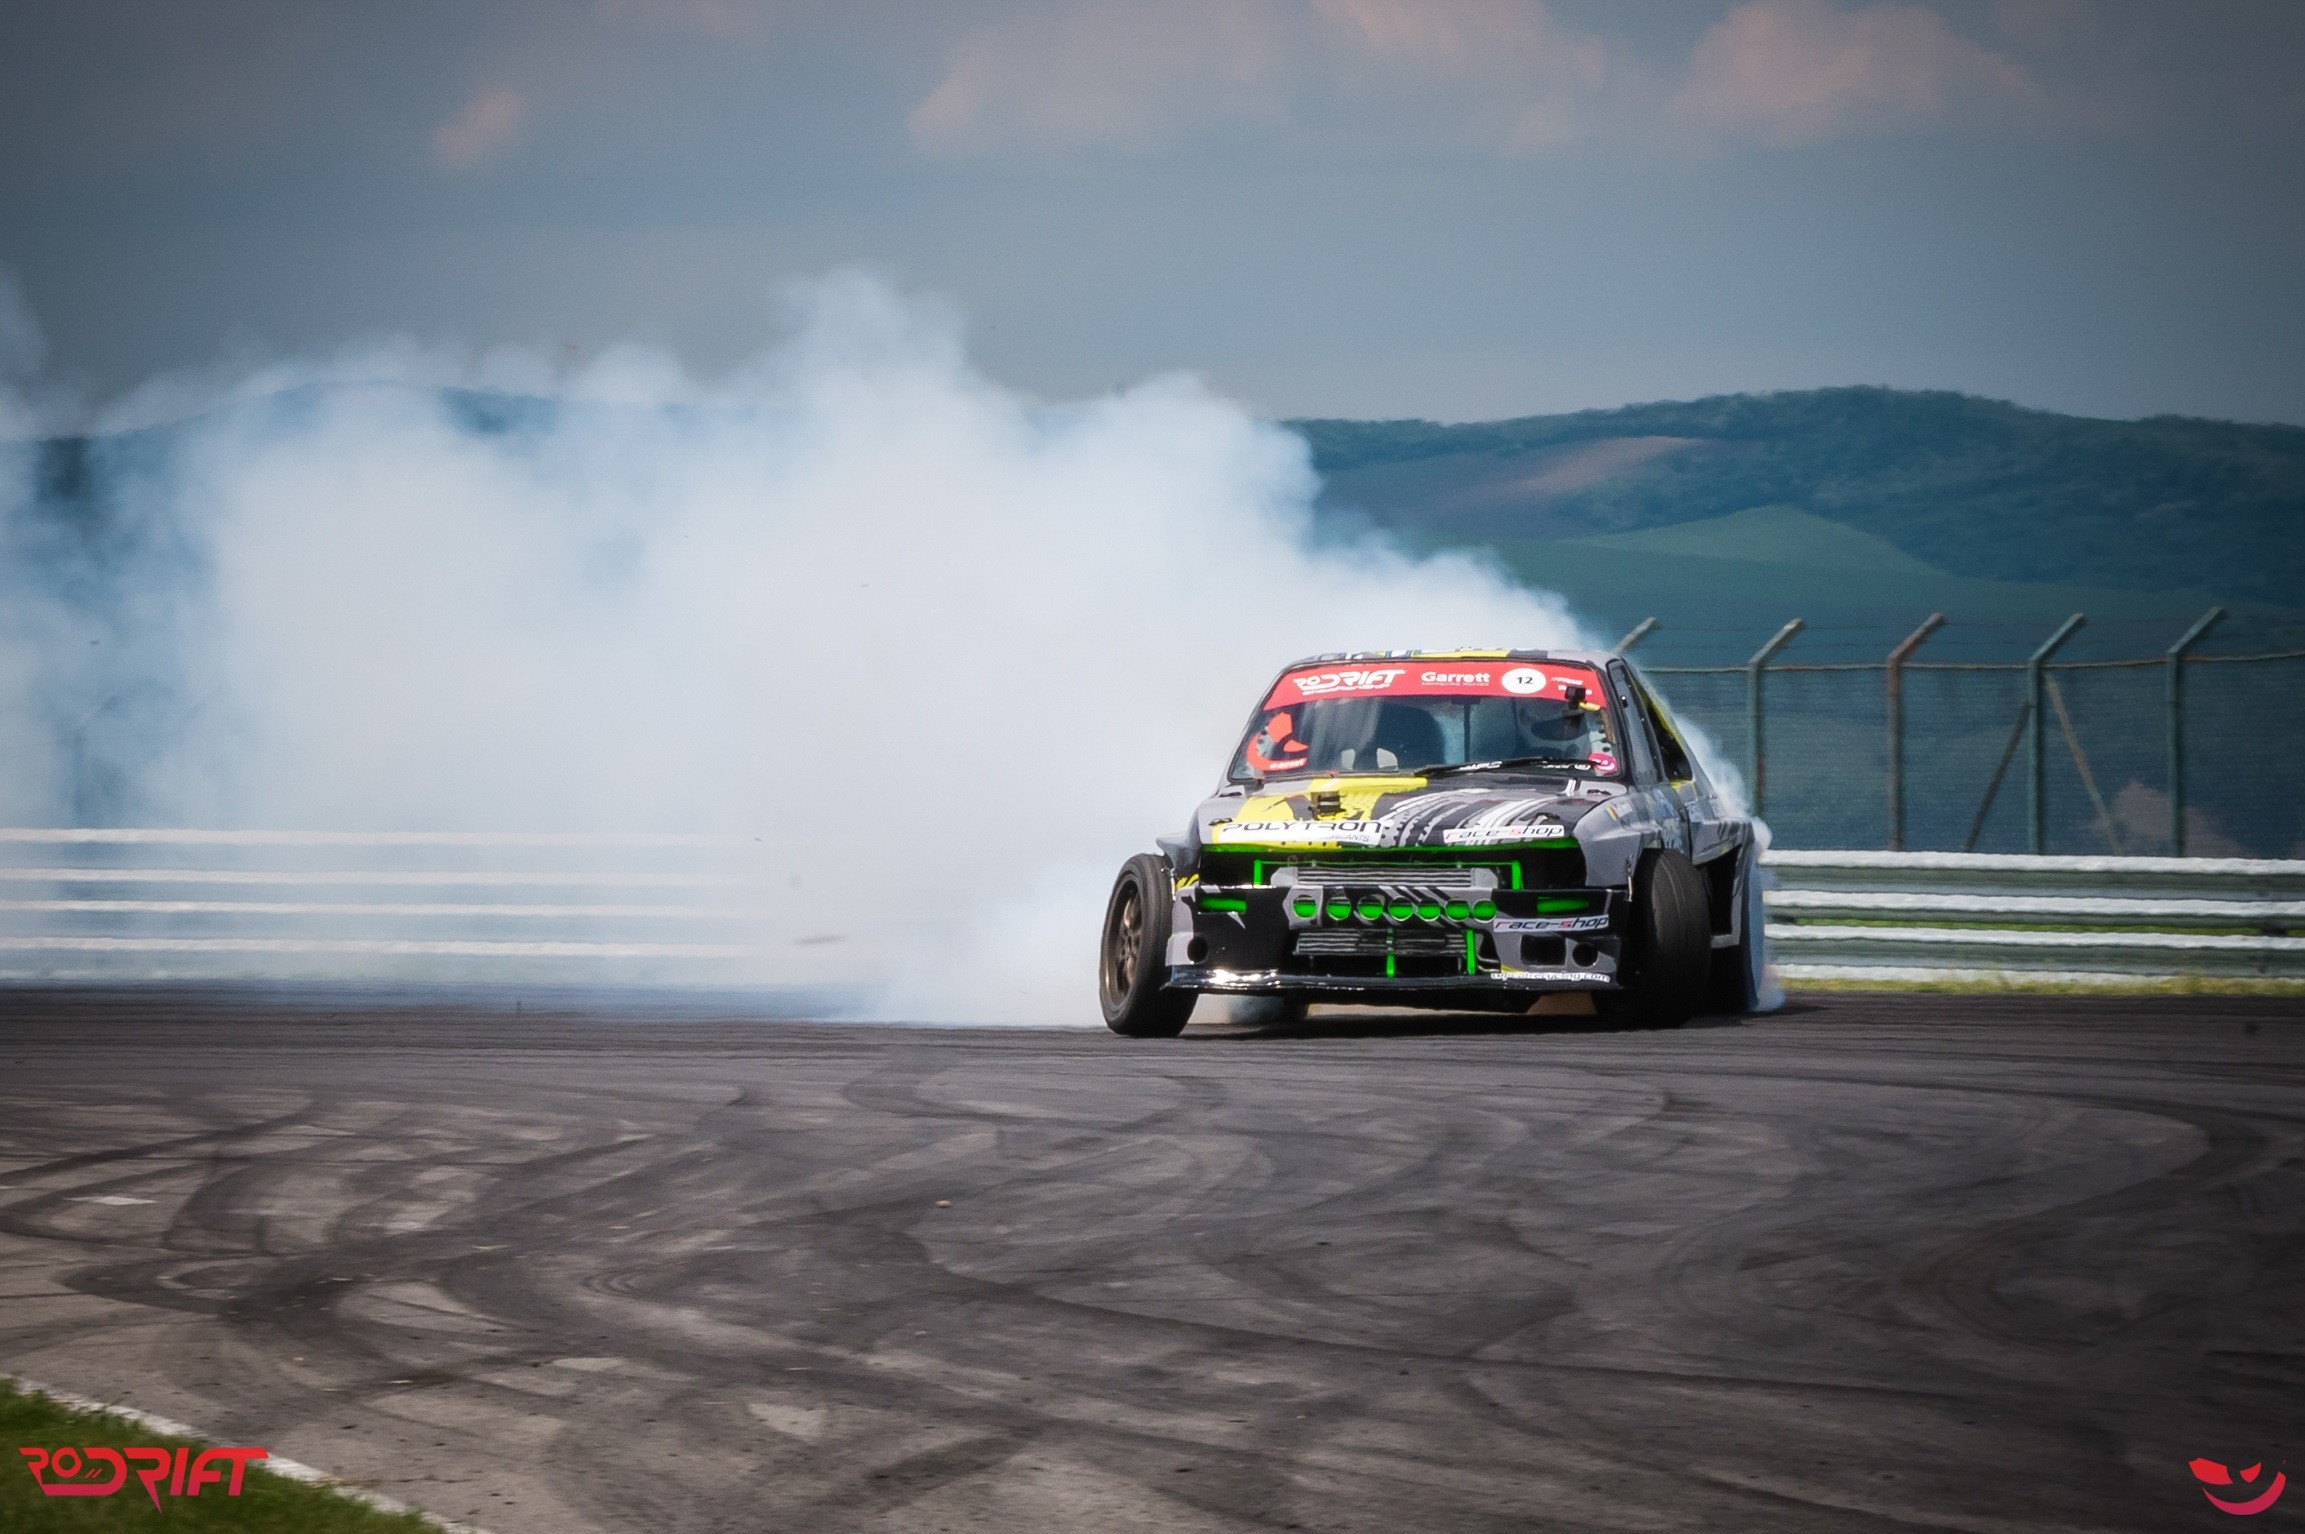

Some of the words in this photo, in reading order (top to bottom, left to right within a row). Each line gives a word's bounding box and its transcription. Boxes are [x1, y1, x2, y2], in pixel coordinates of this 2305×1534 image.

[1421, 671, 1491, 683] Garrett
[1517, 676, 1533, 684] 12
[1223, 821, 1383, 834] POLYTRON
[1445, 826, 1562, 840] race-shop
[1495, 918, 1608, 930] race-shop
